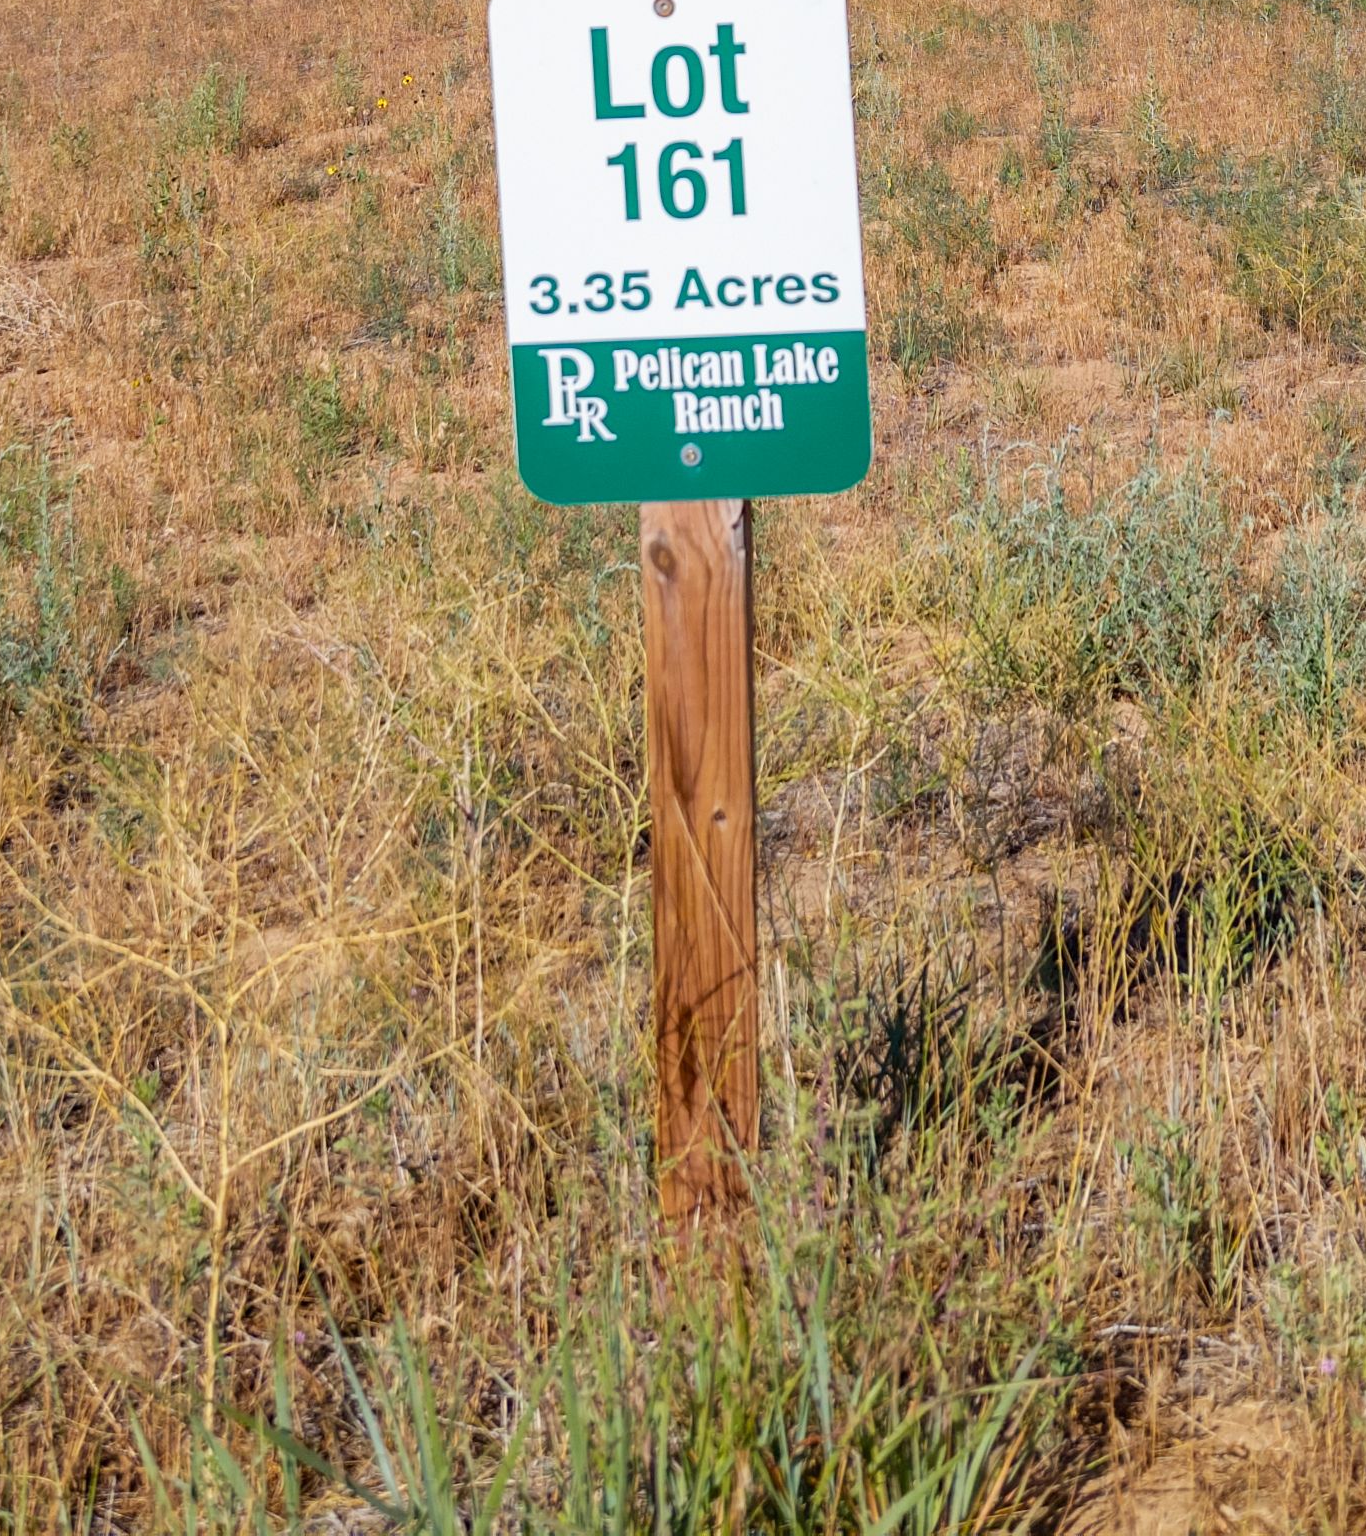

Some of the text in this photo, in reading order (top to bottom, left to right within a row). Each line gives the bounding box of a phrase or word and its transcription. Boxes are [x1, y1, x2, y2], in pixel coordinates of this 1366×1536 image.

[589, 23, 750, 120] Lot
[606, 137, 748, 221] 161
[528, 267, 840, 315] 3.35 Acres
[611, 341, 840, 392] Pelican Lake
[672, 388, 784, 434] Ranch
